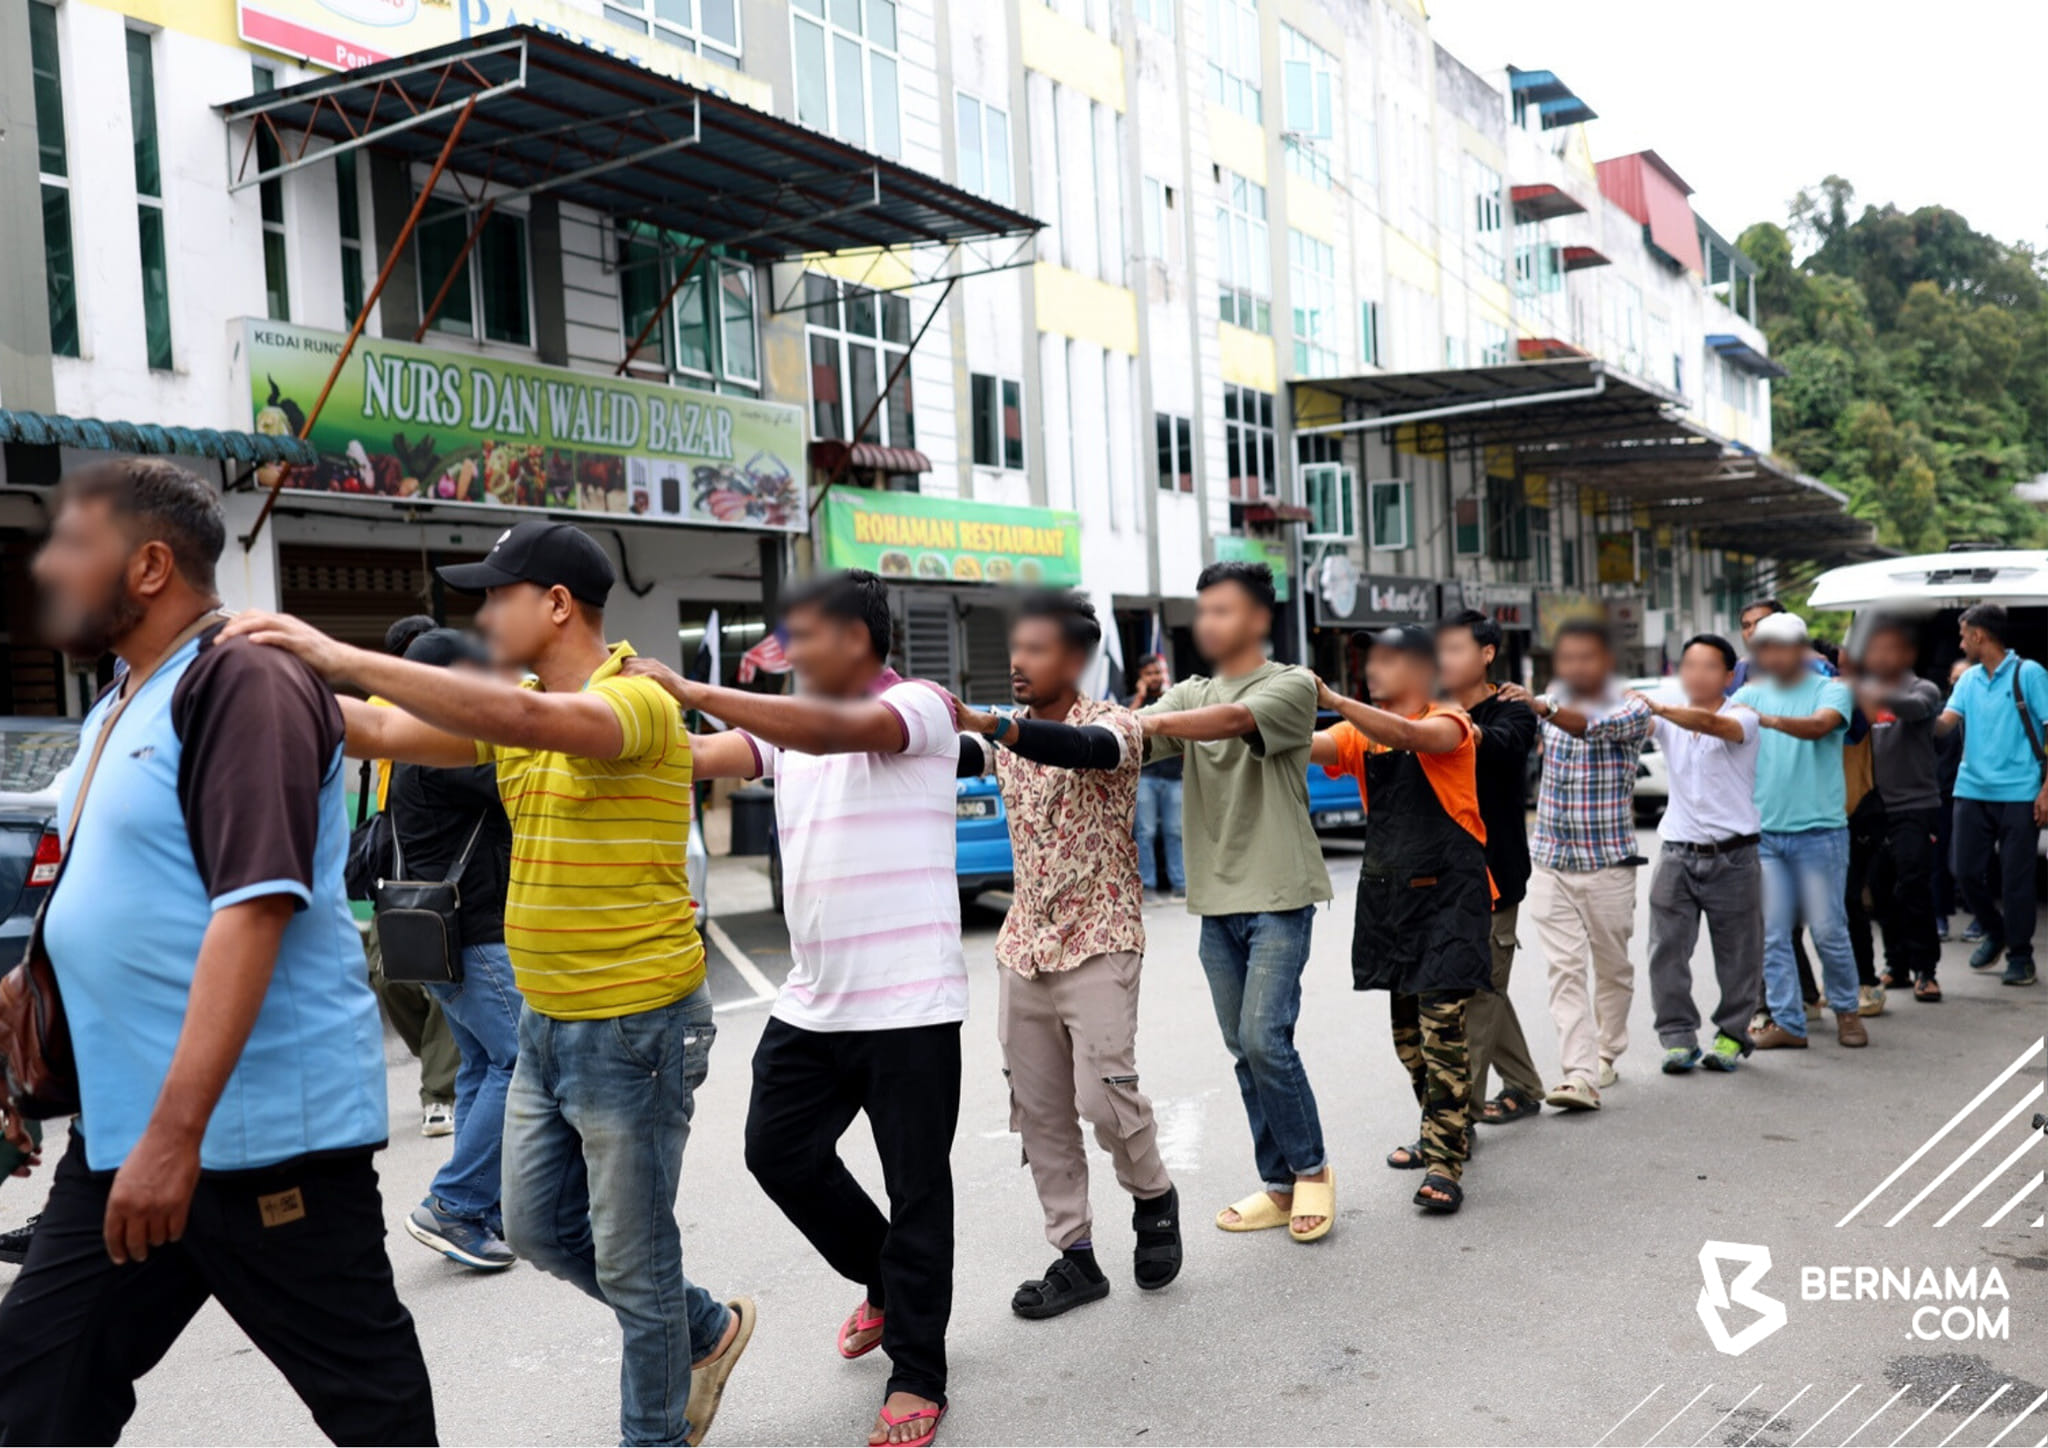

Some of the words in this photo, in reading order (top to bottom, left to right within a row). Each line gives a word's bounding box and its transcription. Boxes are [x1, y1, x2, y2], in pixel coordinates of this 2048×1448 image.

[254, 330, 300, 350] KEDAI
[362, 352, 463, 427] NURS
[469, 369, 542, 437] DAN
[546, 381, 642, 448] WALID
[647, 397, 734, 460] BAZAR
[853, 510, 957, 549] ROHAMAN
[958, 519, 1065, 557] RESTAURANT
